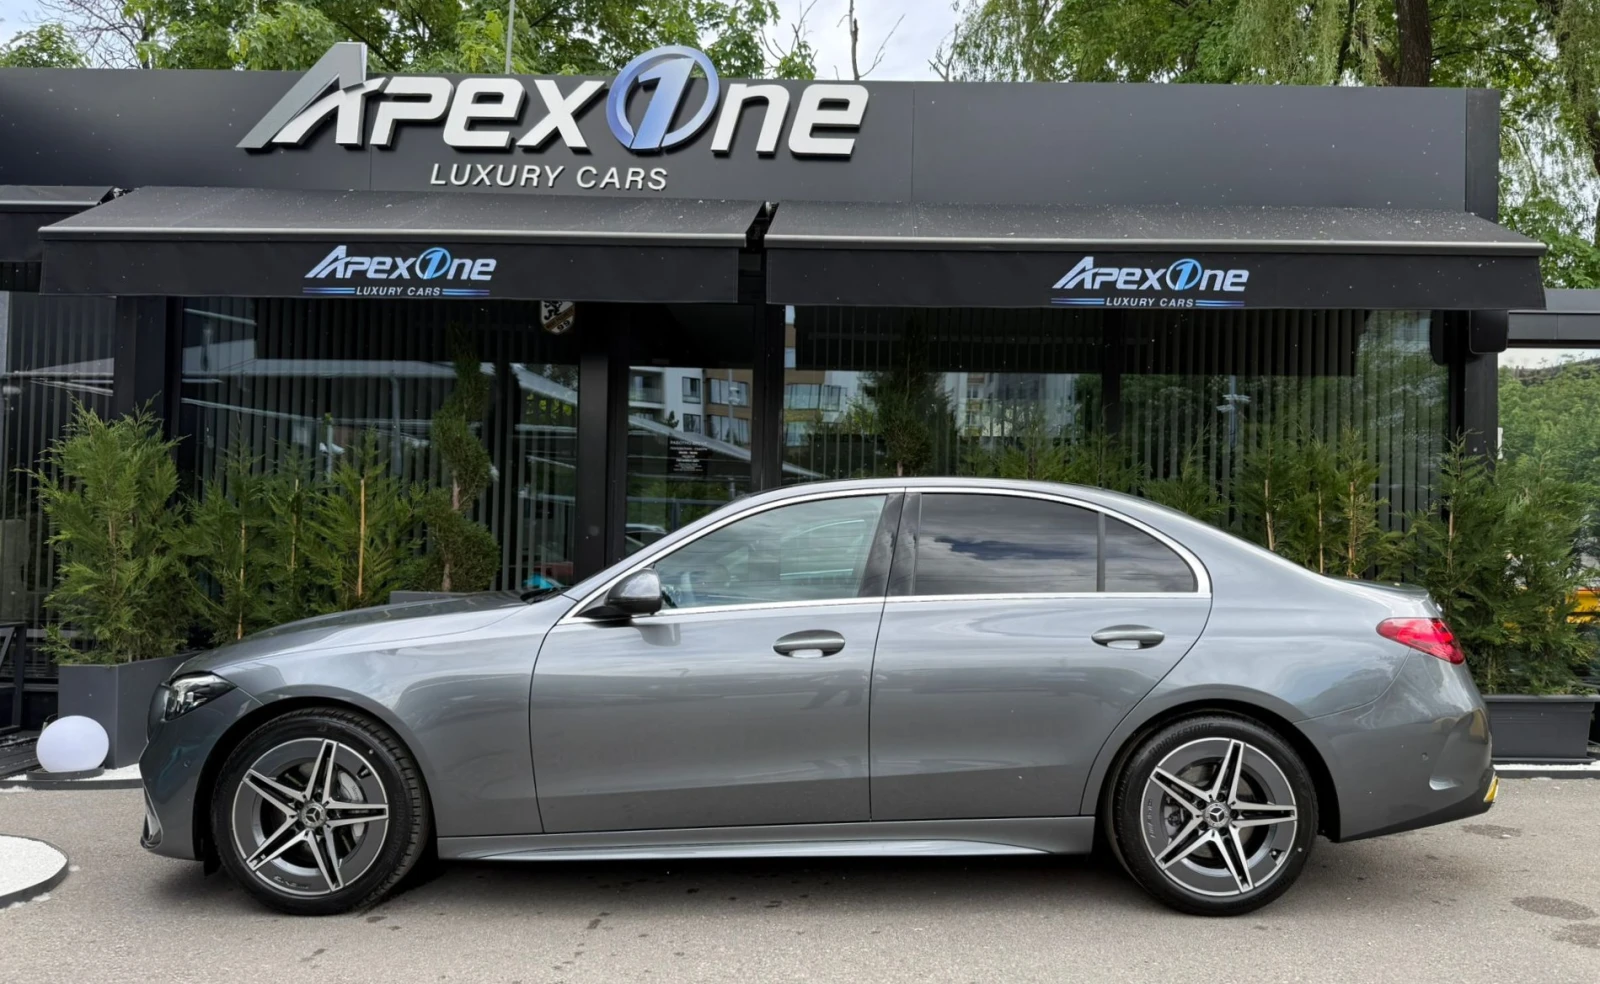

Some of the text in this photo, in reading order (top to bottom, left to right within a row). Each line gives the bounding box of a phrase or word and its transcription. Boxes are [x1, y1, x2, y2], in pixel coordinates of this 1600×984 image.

[430, 163, 668, 191] LUXURY CARS
[356, 286, 441, 297] LUXURY CARS
[1106, 297, 1194, 308] LUXURY CARS
